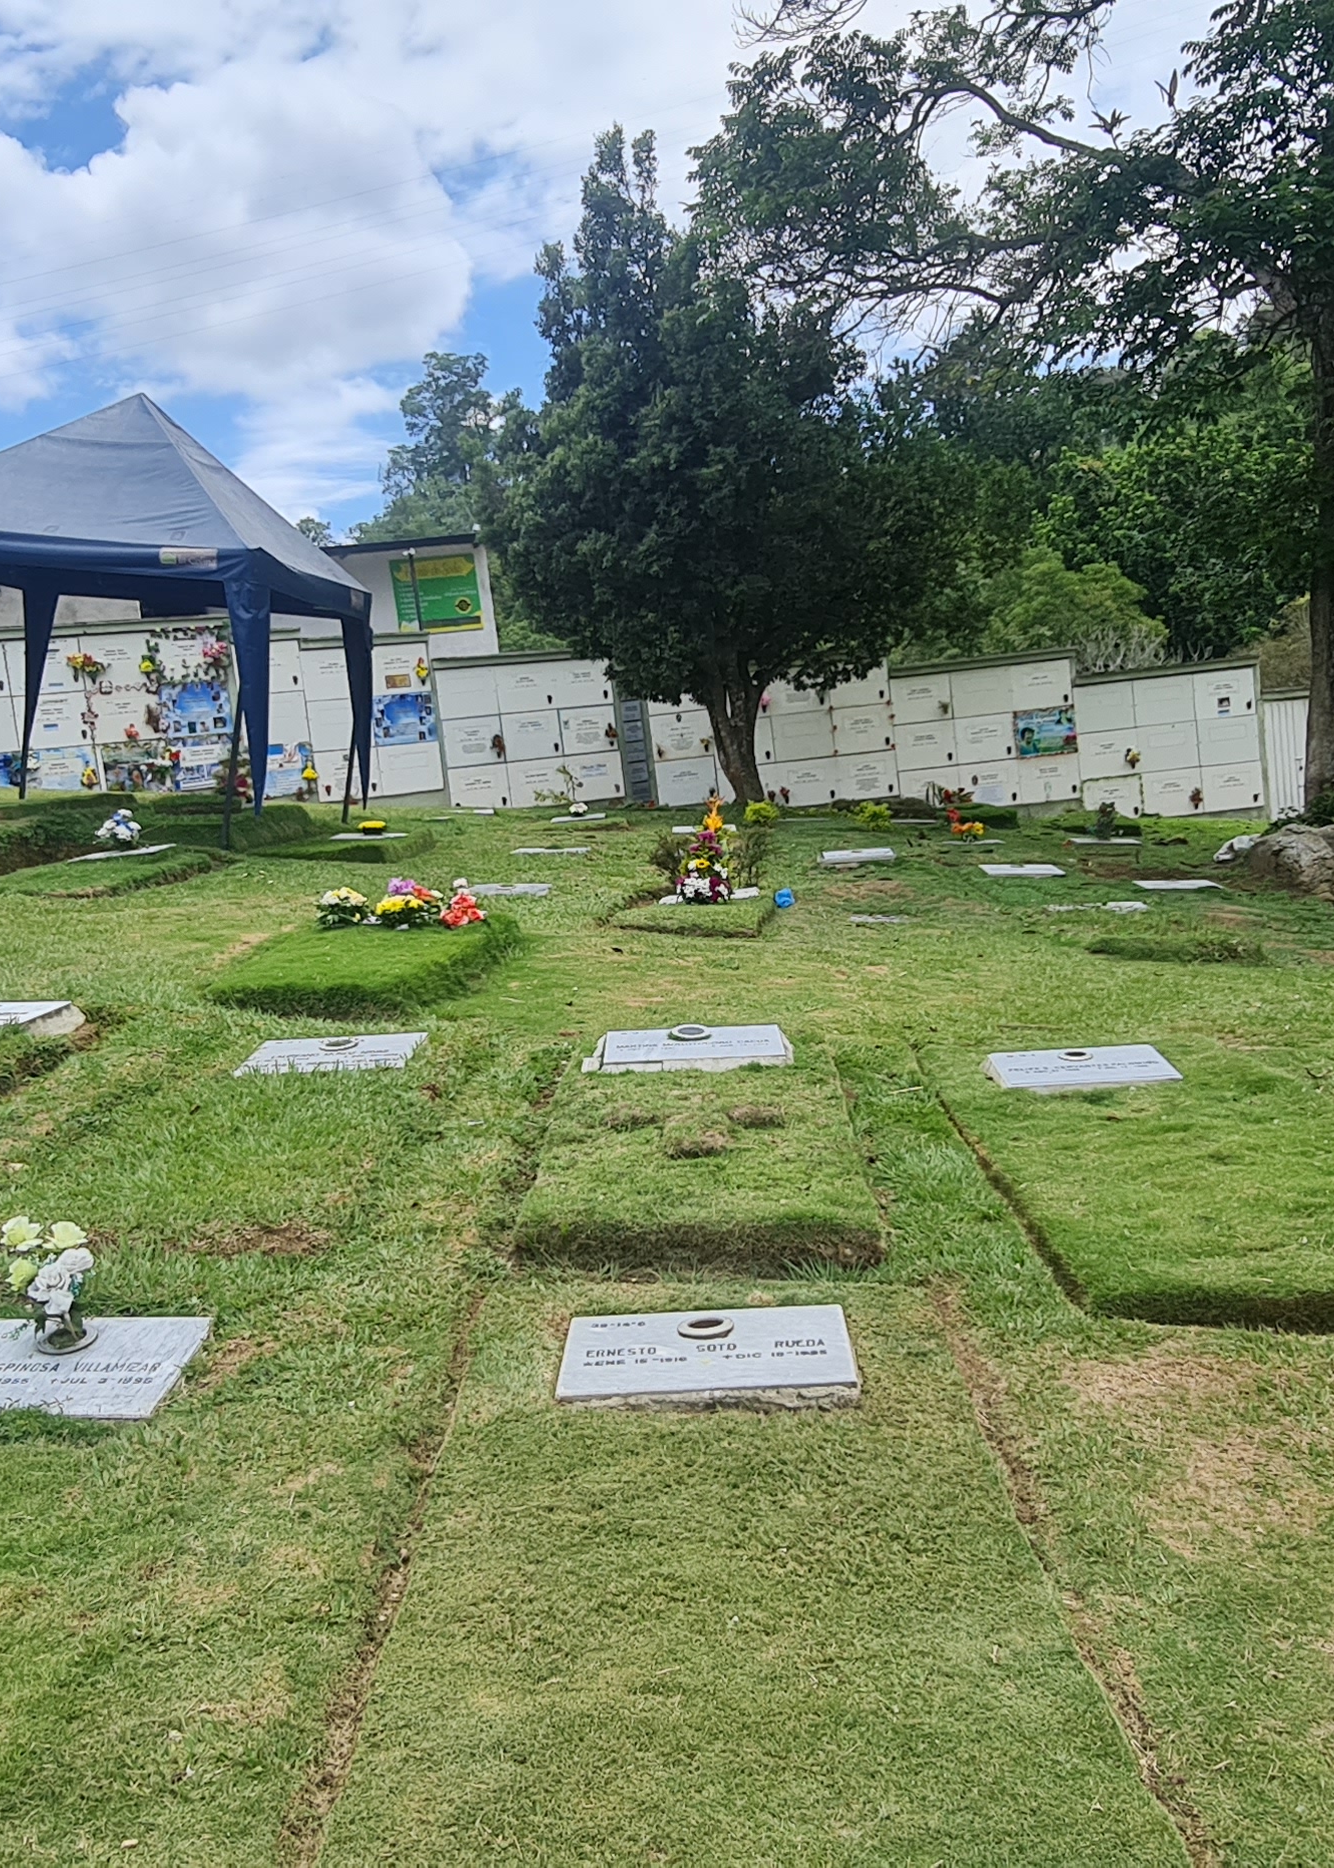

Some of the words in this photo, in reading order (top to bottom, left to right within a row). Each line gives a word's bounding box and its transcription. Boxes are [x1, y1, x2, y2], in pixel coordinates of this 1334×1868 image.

[586, 1347, 657, 1358] ERNESTO
[696, 1342, 737, 1353] SOTO
[774, 1338, 826, 1349] RUEDA
[73, 1360, 162, 1374] VILLAMIZAR
